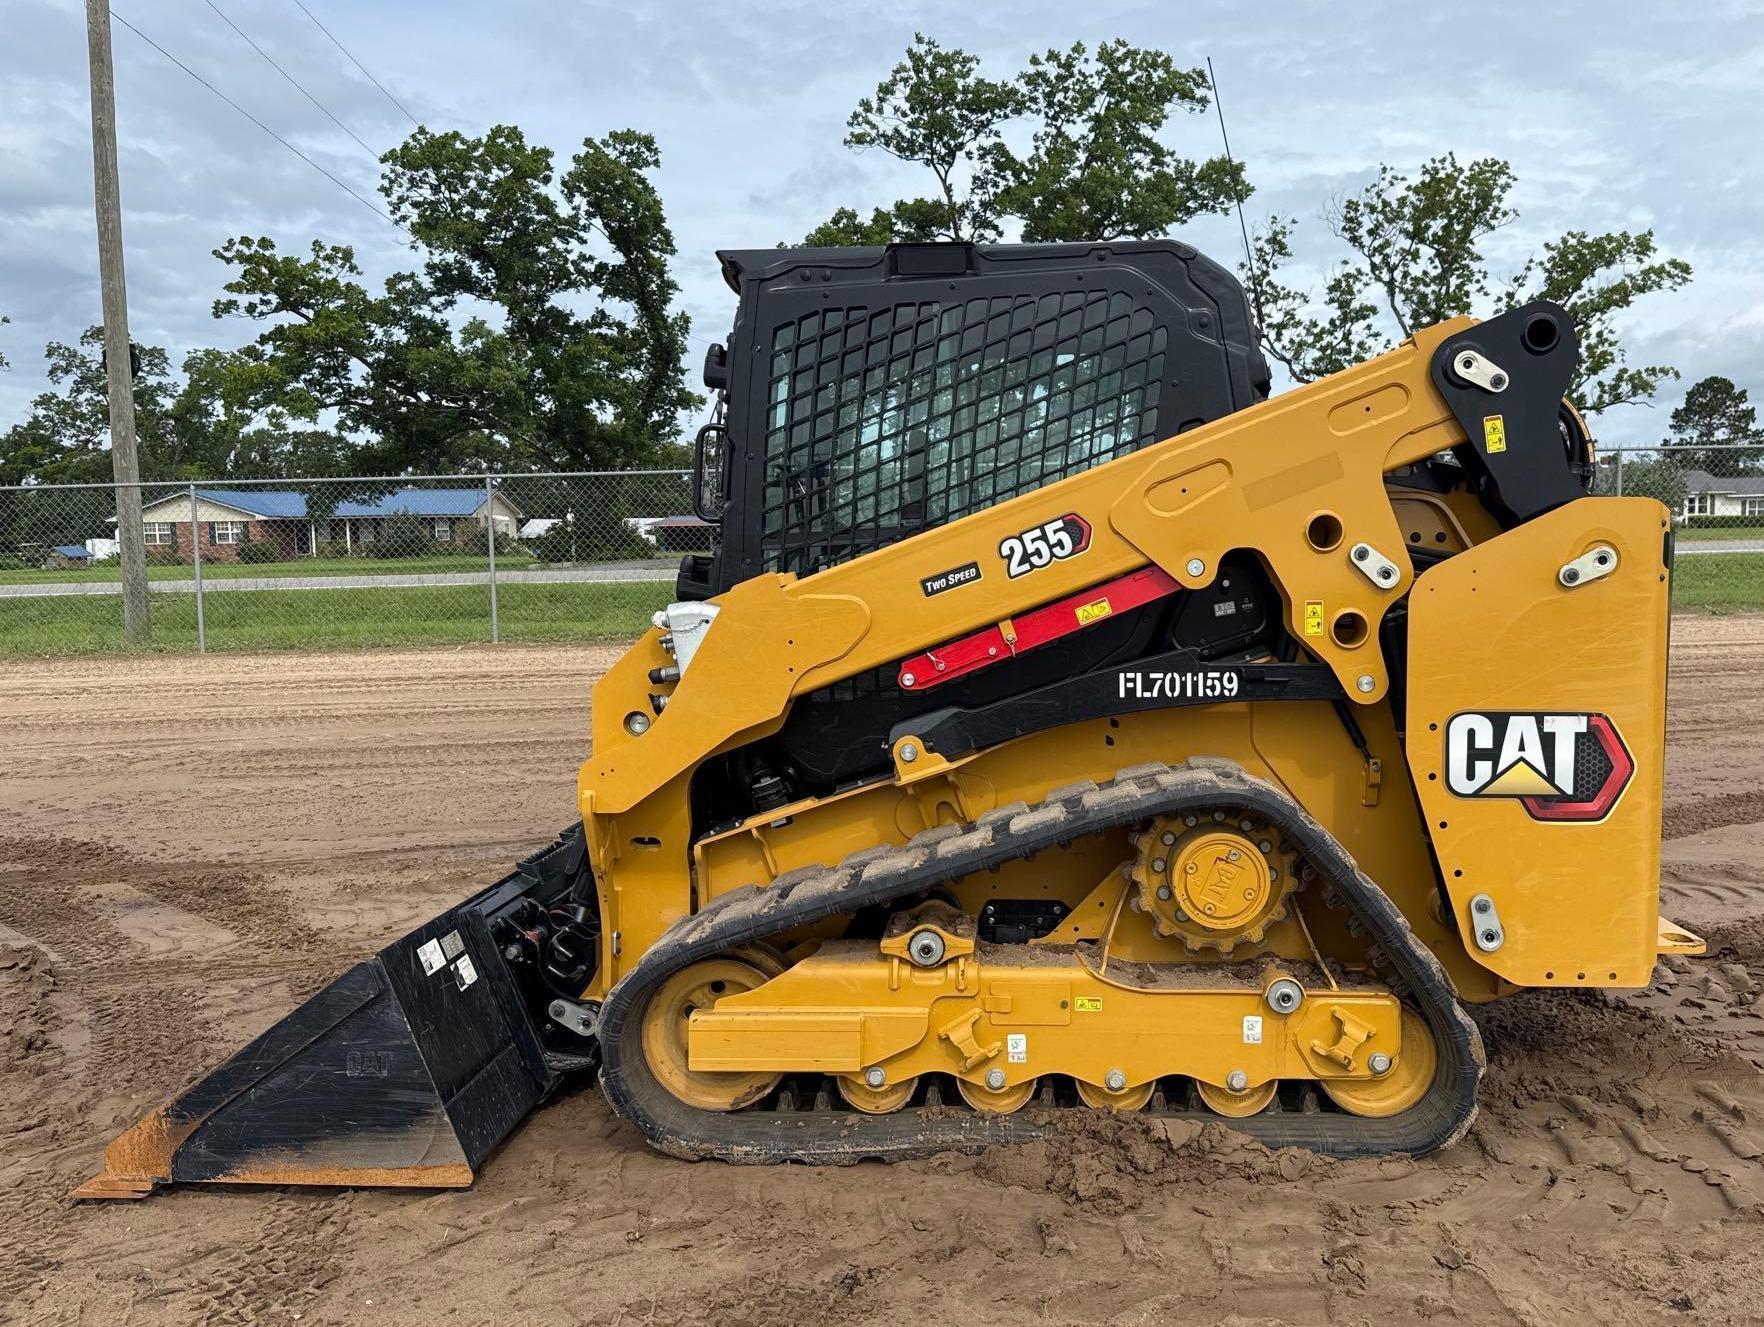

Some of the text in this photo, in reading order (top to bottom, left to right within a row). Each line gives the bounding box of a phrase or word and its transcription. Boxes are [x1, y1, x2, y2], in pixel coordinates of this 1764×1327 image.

[1001, 519, 1073, 577] 255
[1119, 671, 1239, 698] FL701159
[1449, 714, 1588, 795] CAT
